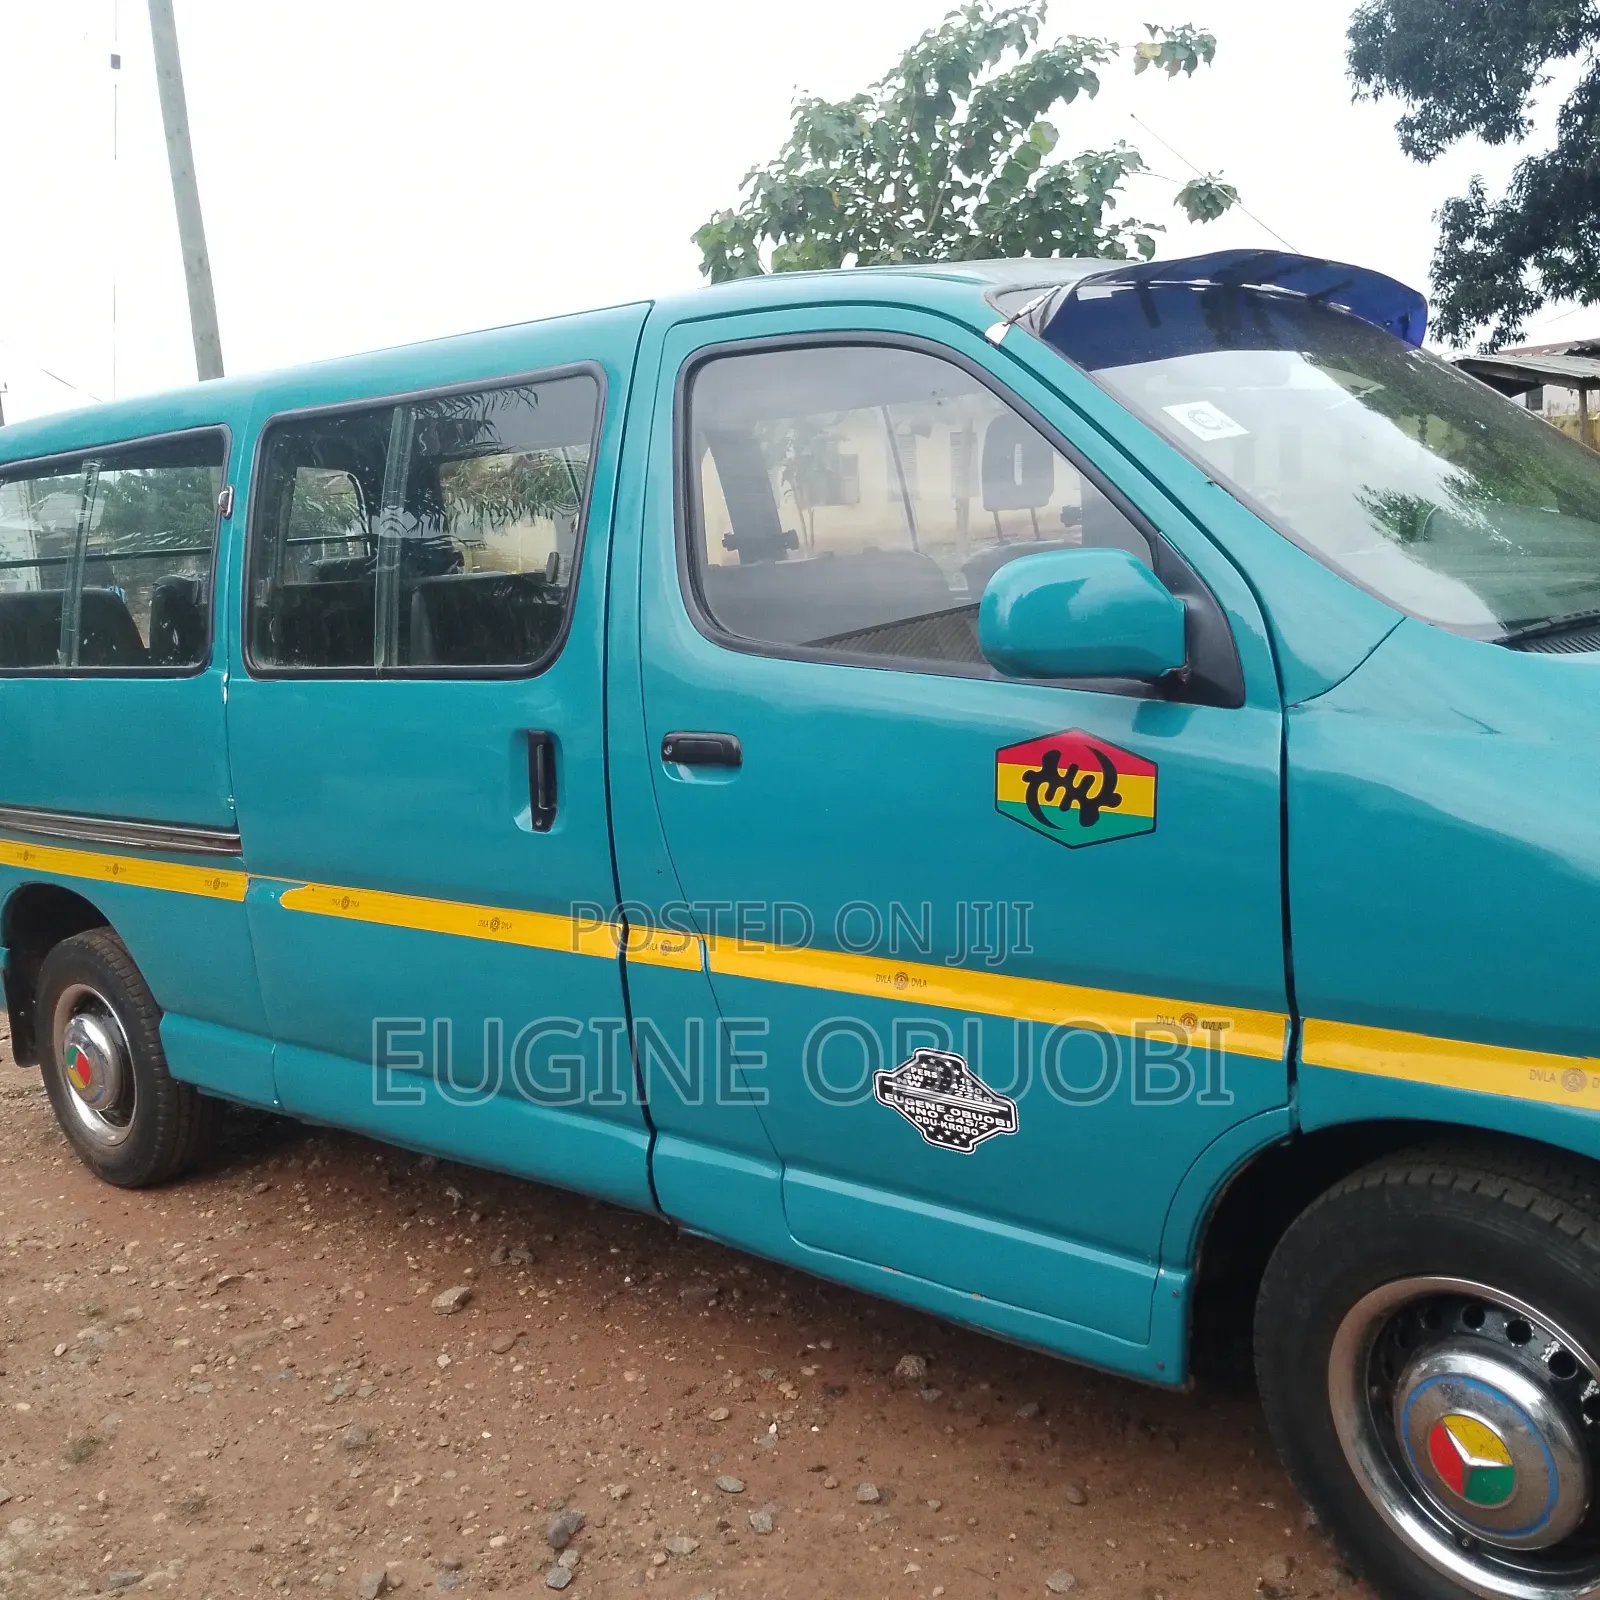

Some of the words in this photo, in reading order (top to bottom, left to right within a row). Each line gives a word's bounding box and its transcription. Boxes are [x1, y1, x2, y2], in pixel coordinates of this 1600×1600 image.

[875, 973, 892, 984] DVLA
[911, 977, 928, 988] DVLA
[1156, 1014, 1177, 1027] DVLA
[1202, 1020, 1224, 1032] DVLA
[910, 1066, 938, 1079] PERS
[1528, 1068, 1557, 1084] DVLA
[896, 1077, 922, 1088] NW
[954, 1089, 993, 1104] 2250
[902, 1072, 924, 1082] GW
[950, 1083, 983, 1095] 4250
[884, 1092, 946, 1113] EUGENE
[950, 1108, 1012, 1128] OBUOBI
[914, 1115, 980, 1136] ODU-KROBO
[943, 1113, 989, 1131] G45/2
